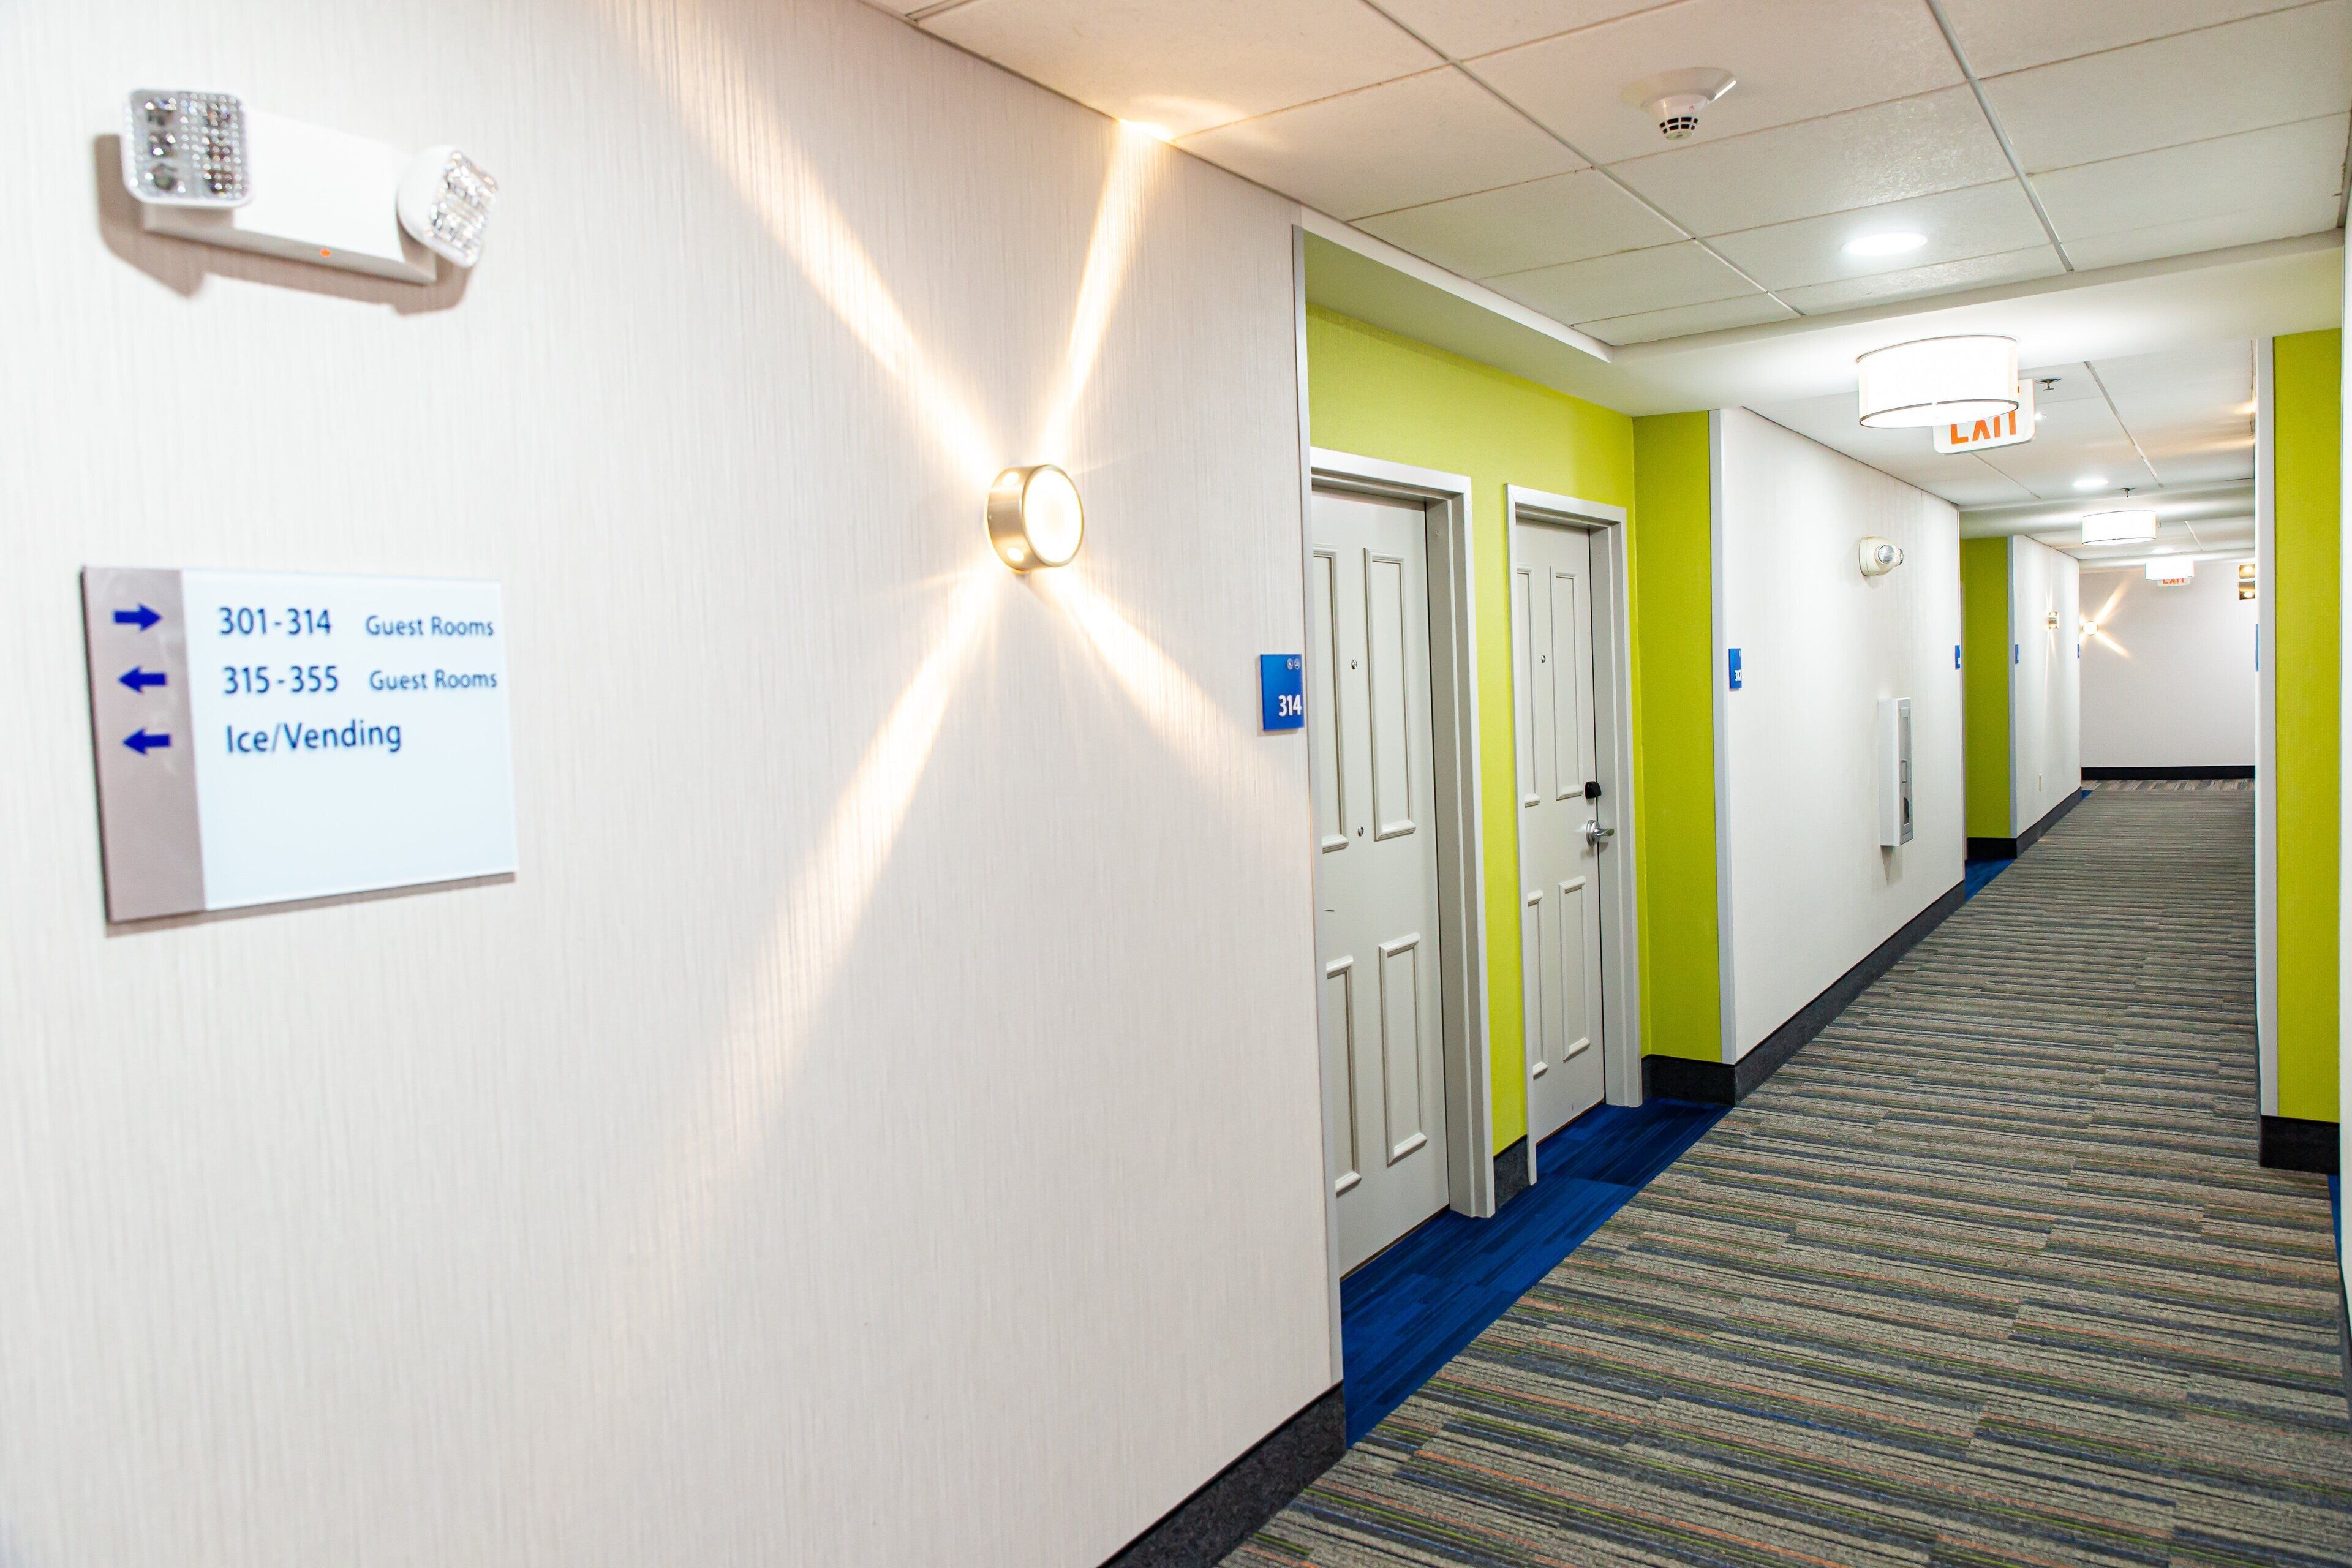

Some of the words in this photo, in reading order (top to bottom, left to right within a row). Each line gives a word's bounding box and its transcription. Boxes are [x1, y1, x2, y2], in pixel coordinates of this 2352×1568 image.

[219, 606, 331, 636] 301-314
[365, 615, 424, 636] Guest
[431, 616, 494, 636] Rooms
[224, 665, 339, 695] 315-355
[369, 669, 428, 691] Guest
[434, 669, 497, 689] Rooms
[1278, 694, 1302, 717] 314
[226, 719, 401, 754] Ice/Vending
